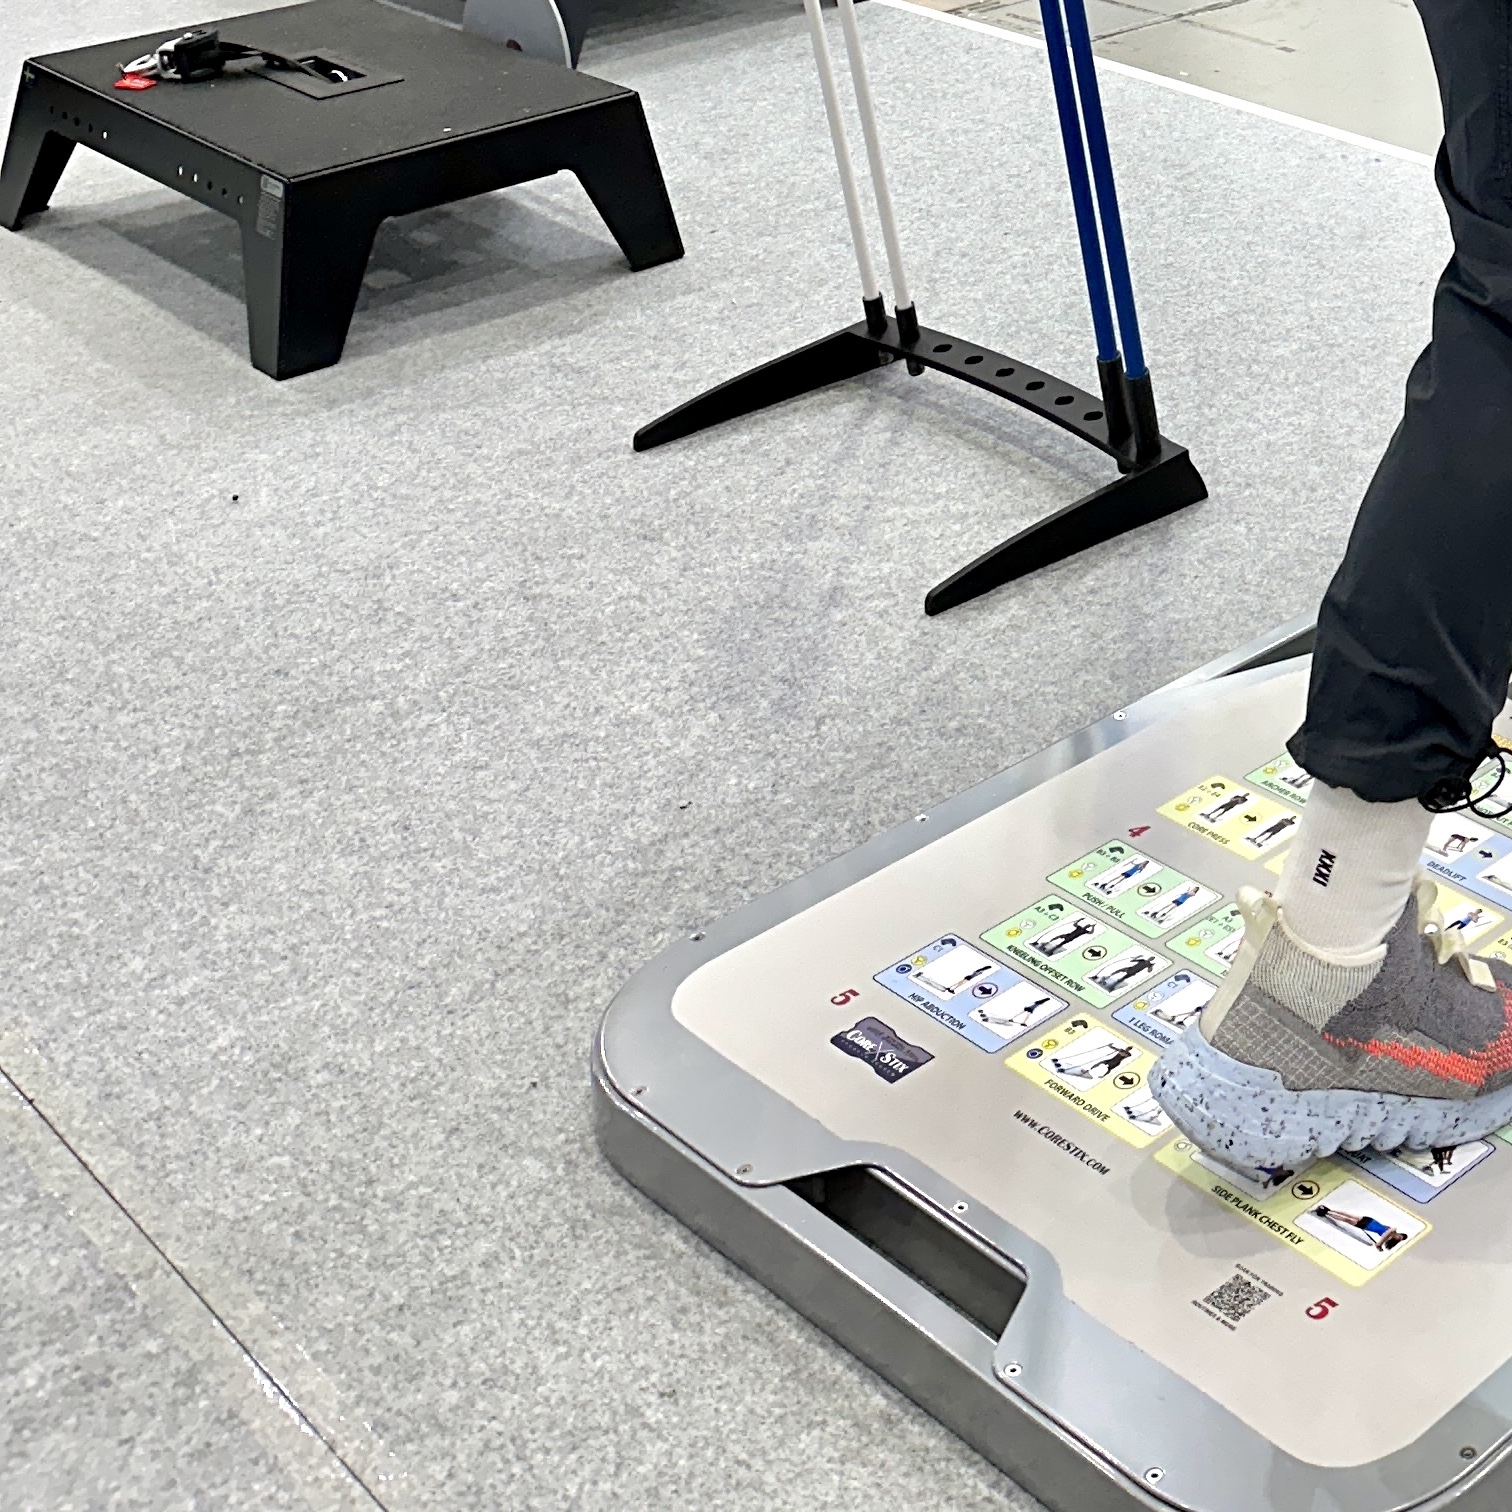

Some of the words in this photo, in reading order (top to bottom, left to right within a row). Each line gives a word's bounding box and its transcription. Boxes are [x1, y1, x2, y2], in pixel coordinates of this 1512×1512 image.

[1128, 825, 1151, 838] 4
[1426, 860, 1467, 883] DEADLIFT
[1082, 892, 1103, 907] PUSH
[1106, 904, 1126, 920] PULL
[1006, 944, 1039, 971] KNEELING
[1037, 963, 1066, 983] OFFSET
[1064, 977, 1086, 993] ROW
[831, 988, 860, 1006] 5
[908, 992, 924, 1006] HIP
[921, 1000, 967, 1032] ABDUCTION
[1133, 1019, 1150, 1034] LEG
[846, 1029, 876, 1053] CORE
[880, 1052, 910, 1074] STIX
[1043, 1078, 1084, 1108] FORWARD
[1082, 1102, 1111, 1123] DRIVE
[1211, 1185, 1233, 1202] SIDE
[1232, 1195, 1261, 1219] PLANK
[1258, 1214, 1288, 1236] CHEST
[1286, 1230, 1304, 1246] FLY
[1305, 1297, 1339, 1321] 5
